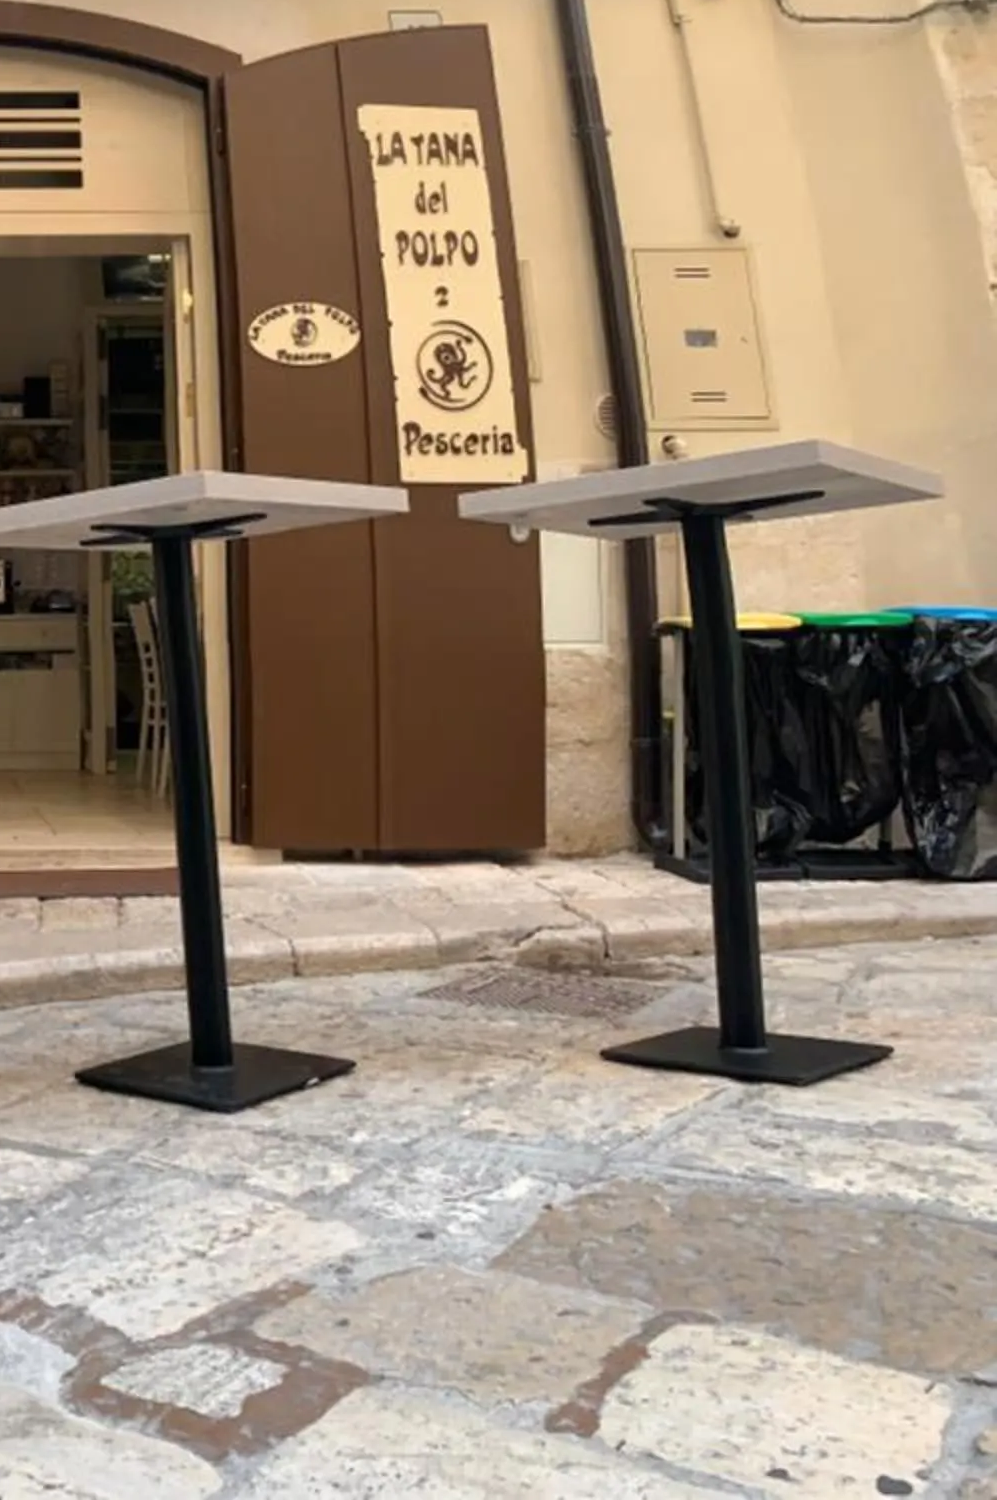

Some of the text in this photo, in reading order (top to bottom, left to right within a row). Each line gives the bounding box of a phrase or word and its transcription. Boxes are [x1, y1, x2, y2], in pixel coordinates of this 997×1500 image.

[375, 131, 479, 167] LA TANA
[414, 181, 448, 215] del
[394, 230, 480, 267] POLPO
[434, 285, 449, 307] 2
[402, 421, 514, 457] Pesceria
